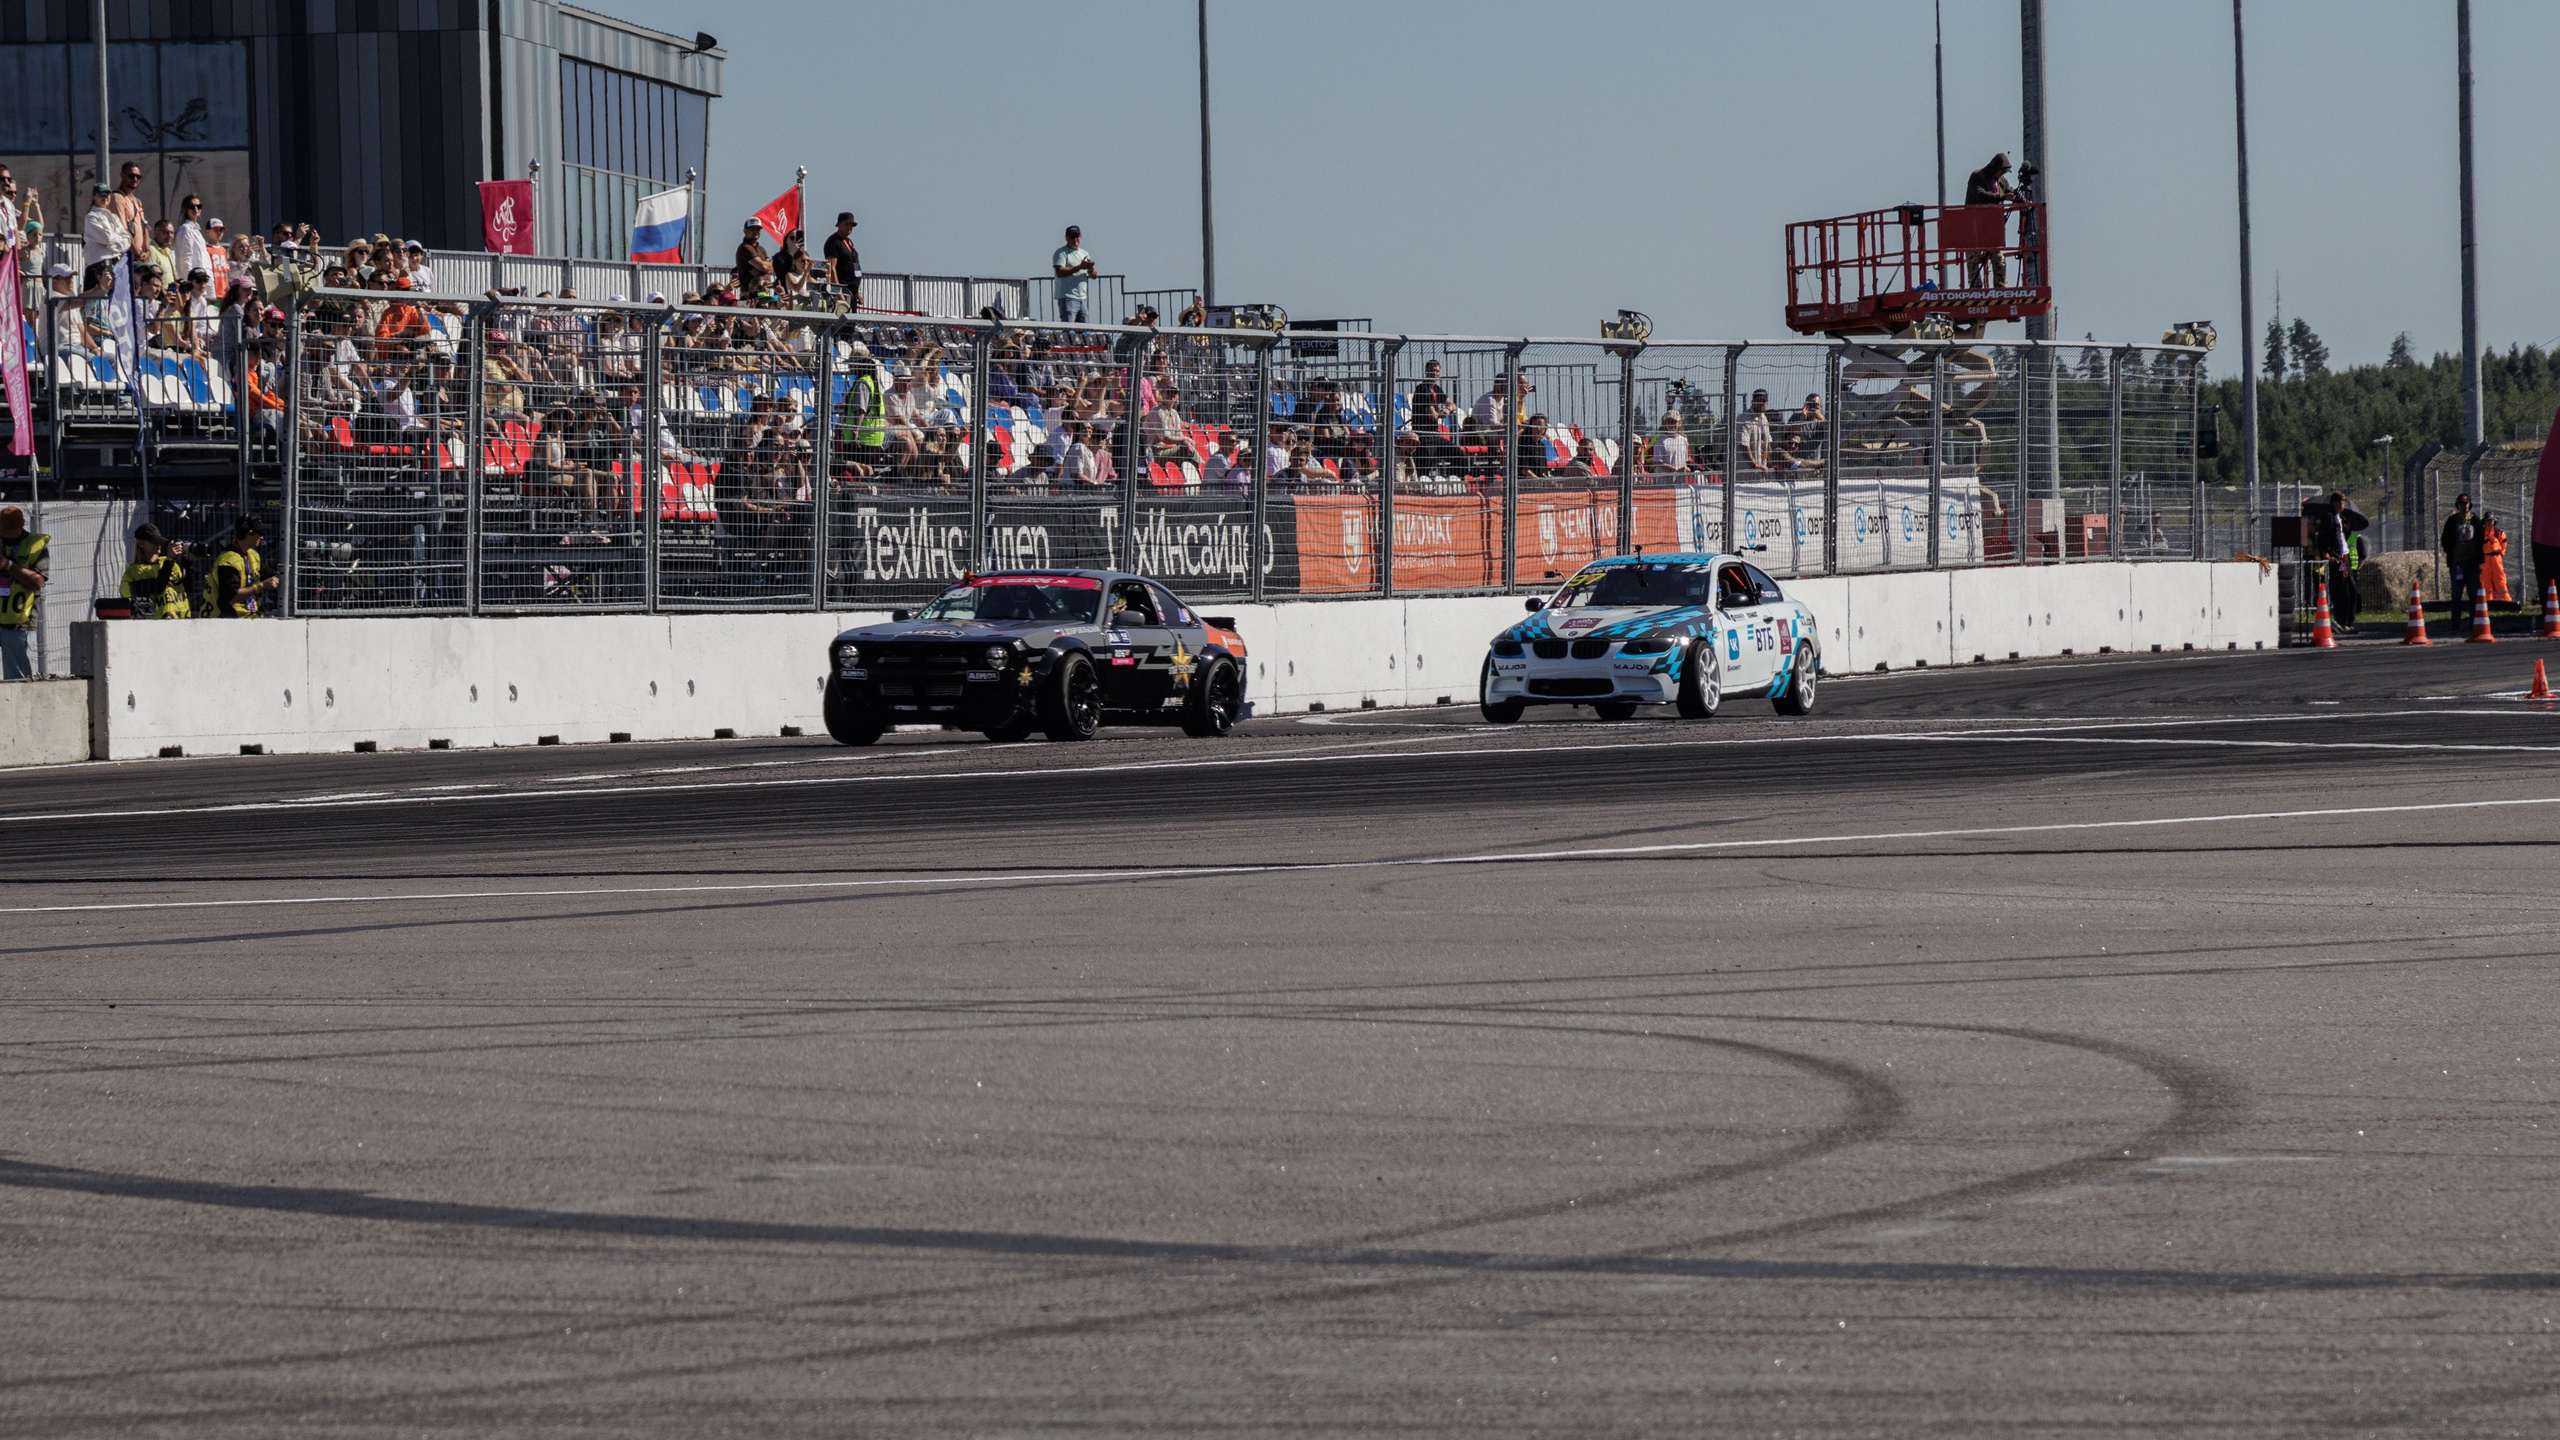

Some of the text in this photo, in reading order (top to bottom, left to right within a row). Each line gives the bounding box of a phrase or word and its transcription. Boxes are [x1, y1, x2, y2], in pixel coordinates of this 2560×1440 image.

[1967, 306, 1989, 314] GE036
[1567, 573, 1608, 587] 97
[1729, 637, 1739, 652] VK
[1756, 627, 1774, 652] ВТБ
